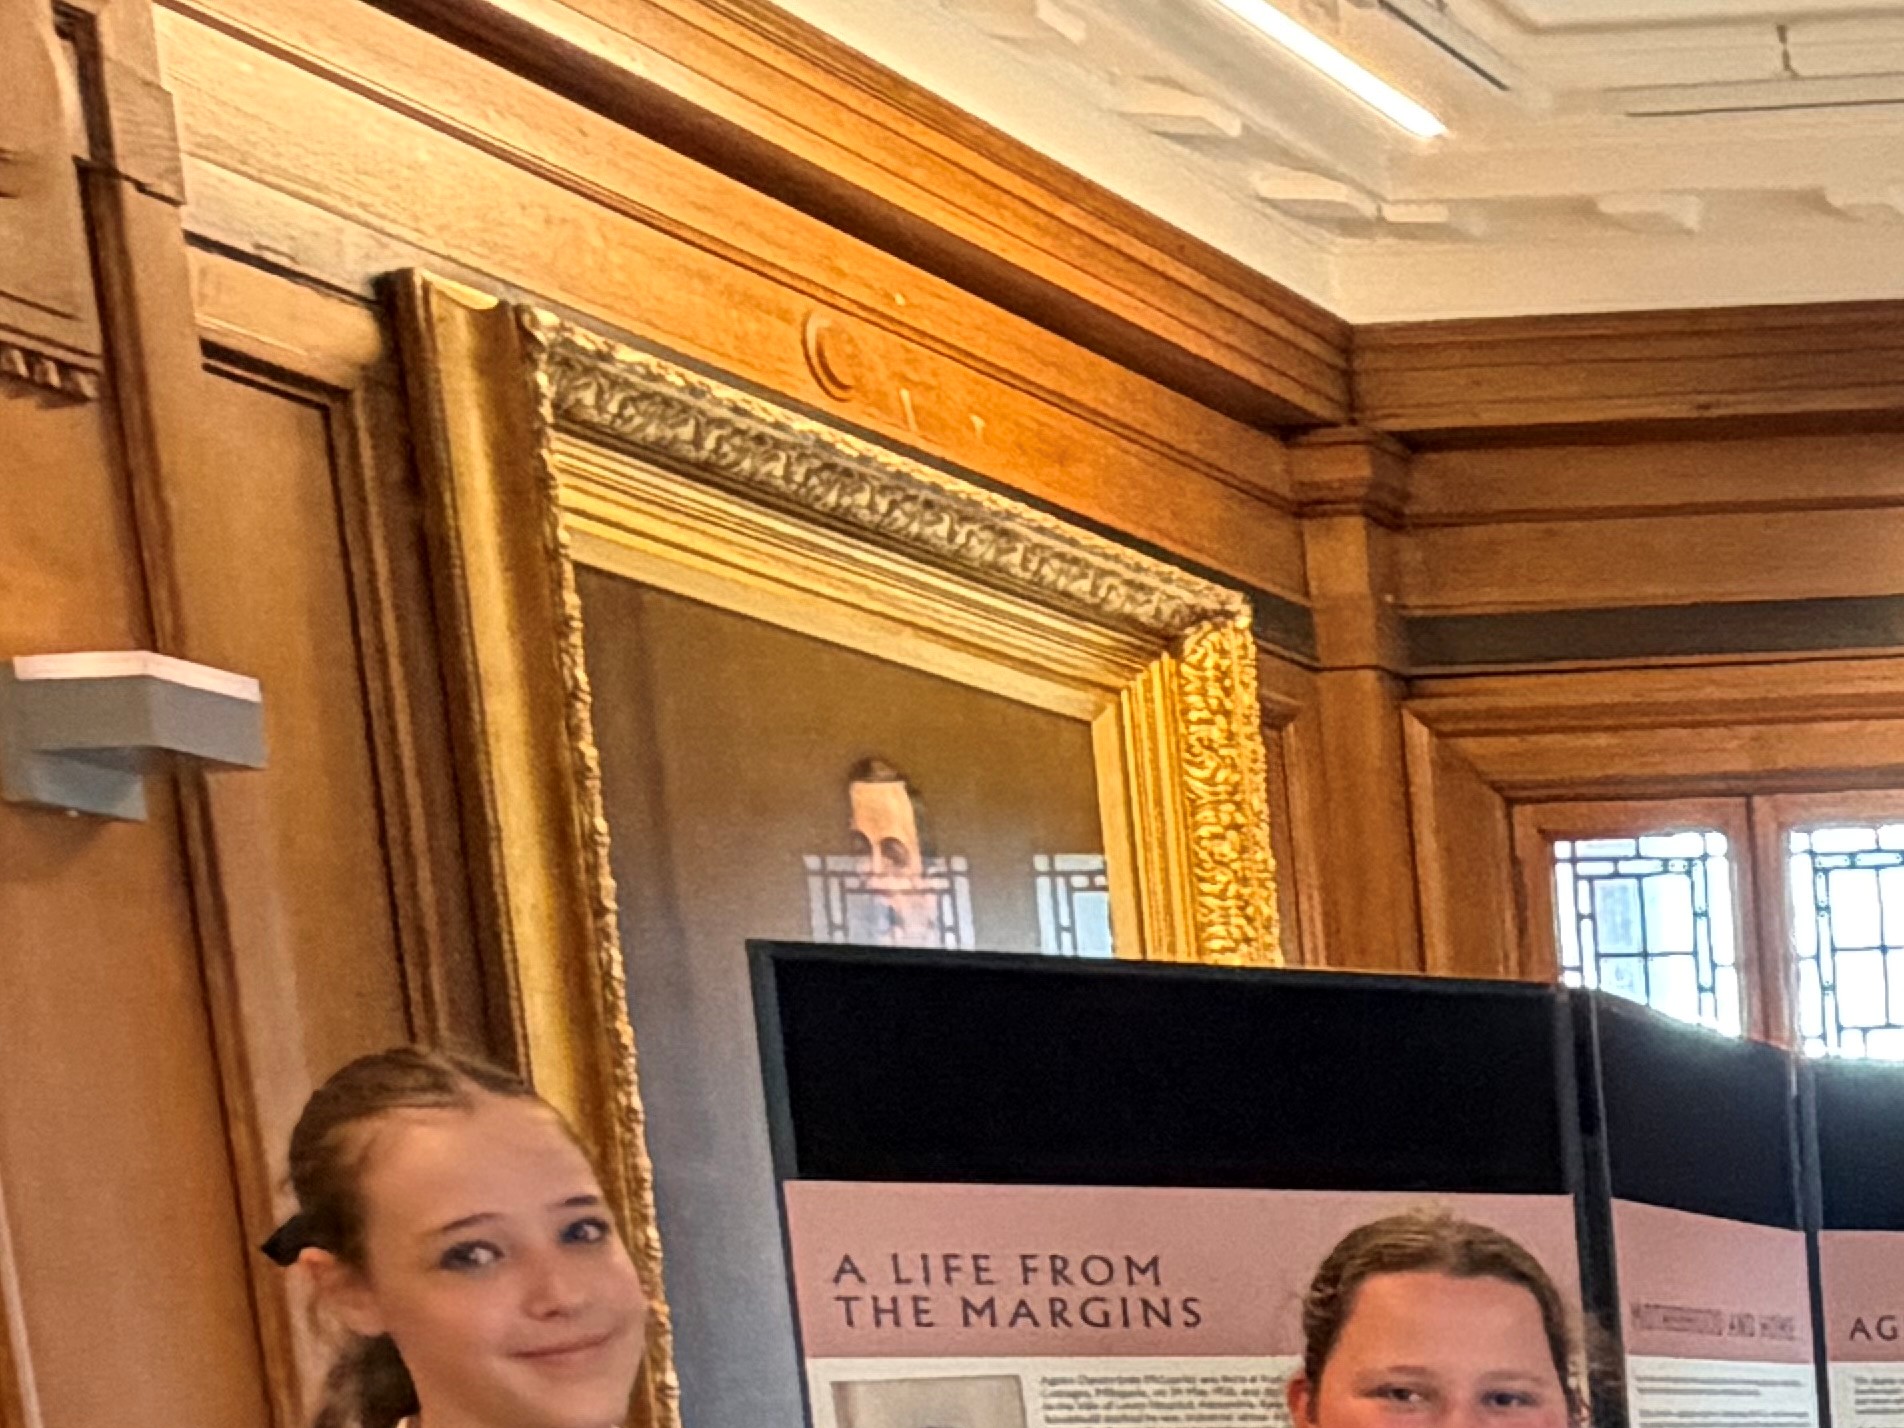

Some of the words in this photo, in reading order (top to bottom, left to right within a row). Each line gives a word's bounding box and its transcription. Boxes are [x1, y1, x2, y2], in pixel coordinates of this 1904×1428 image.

[833, 1254, 866, 1285] A
[891, 1253, 996, 1286] LIFE
[1020, 1254, 1162, 1286] FROM
[835, 1297, 936, 1328] THE
[961, 1297, 1202, 1328] MARGINS
